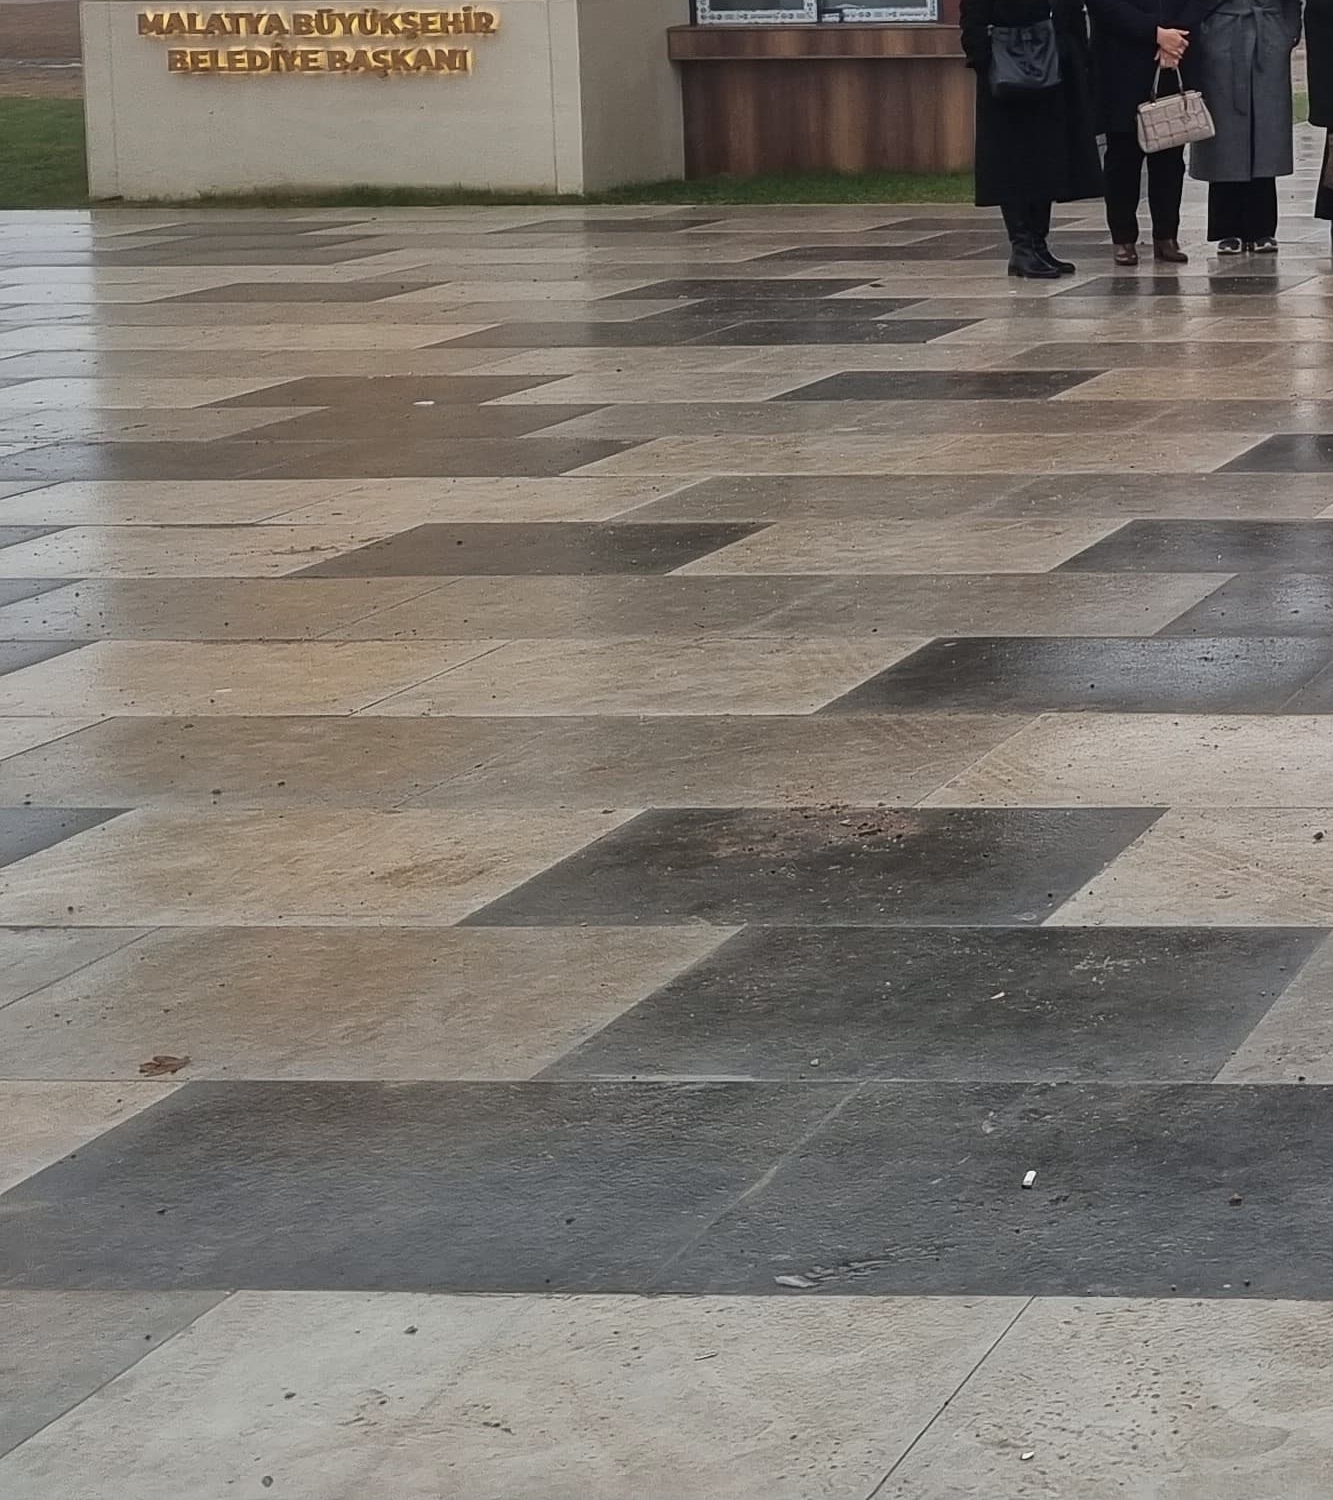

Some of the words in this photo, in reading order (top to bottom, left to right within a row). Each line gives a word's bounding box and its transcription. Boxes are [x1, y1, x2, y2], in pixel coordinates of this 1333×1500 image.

[138, 12, 289, 36] MALATYA
[292, 5, 496, 40] BÜYÜKŞEHİR
[168, 42, 325, 72] BELEDİYE
[328, 48, 469, 77] BAŞKANI
